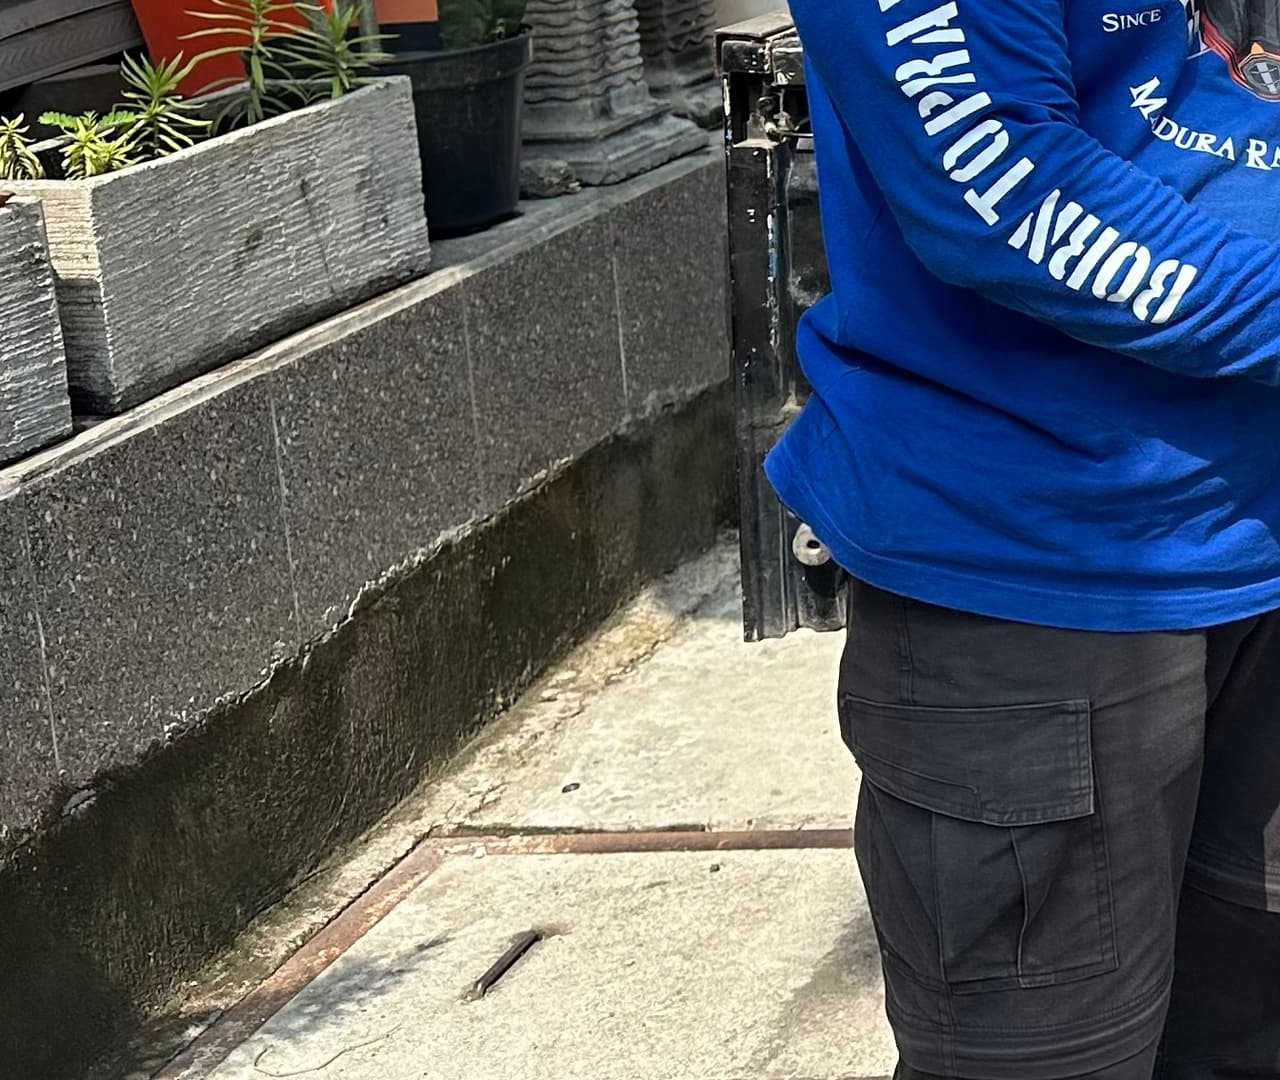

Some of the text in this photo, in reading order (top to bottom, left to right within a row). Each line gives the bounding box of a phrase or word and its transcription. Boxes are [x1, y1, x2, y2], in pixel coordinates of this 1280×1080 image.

[1102, 8, 1162, 32] SINCE
[942, 119, 1035, 226] TO
[1007, 188, 1198, 324] BORN
